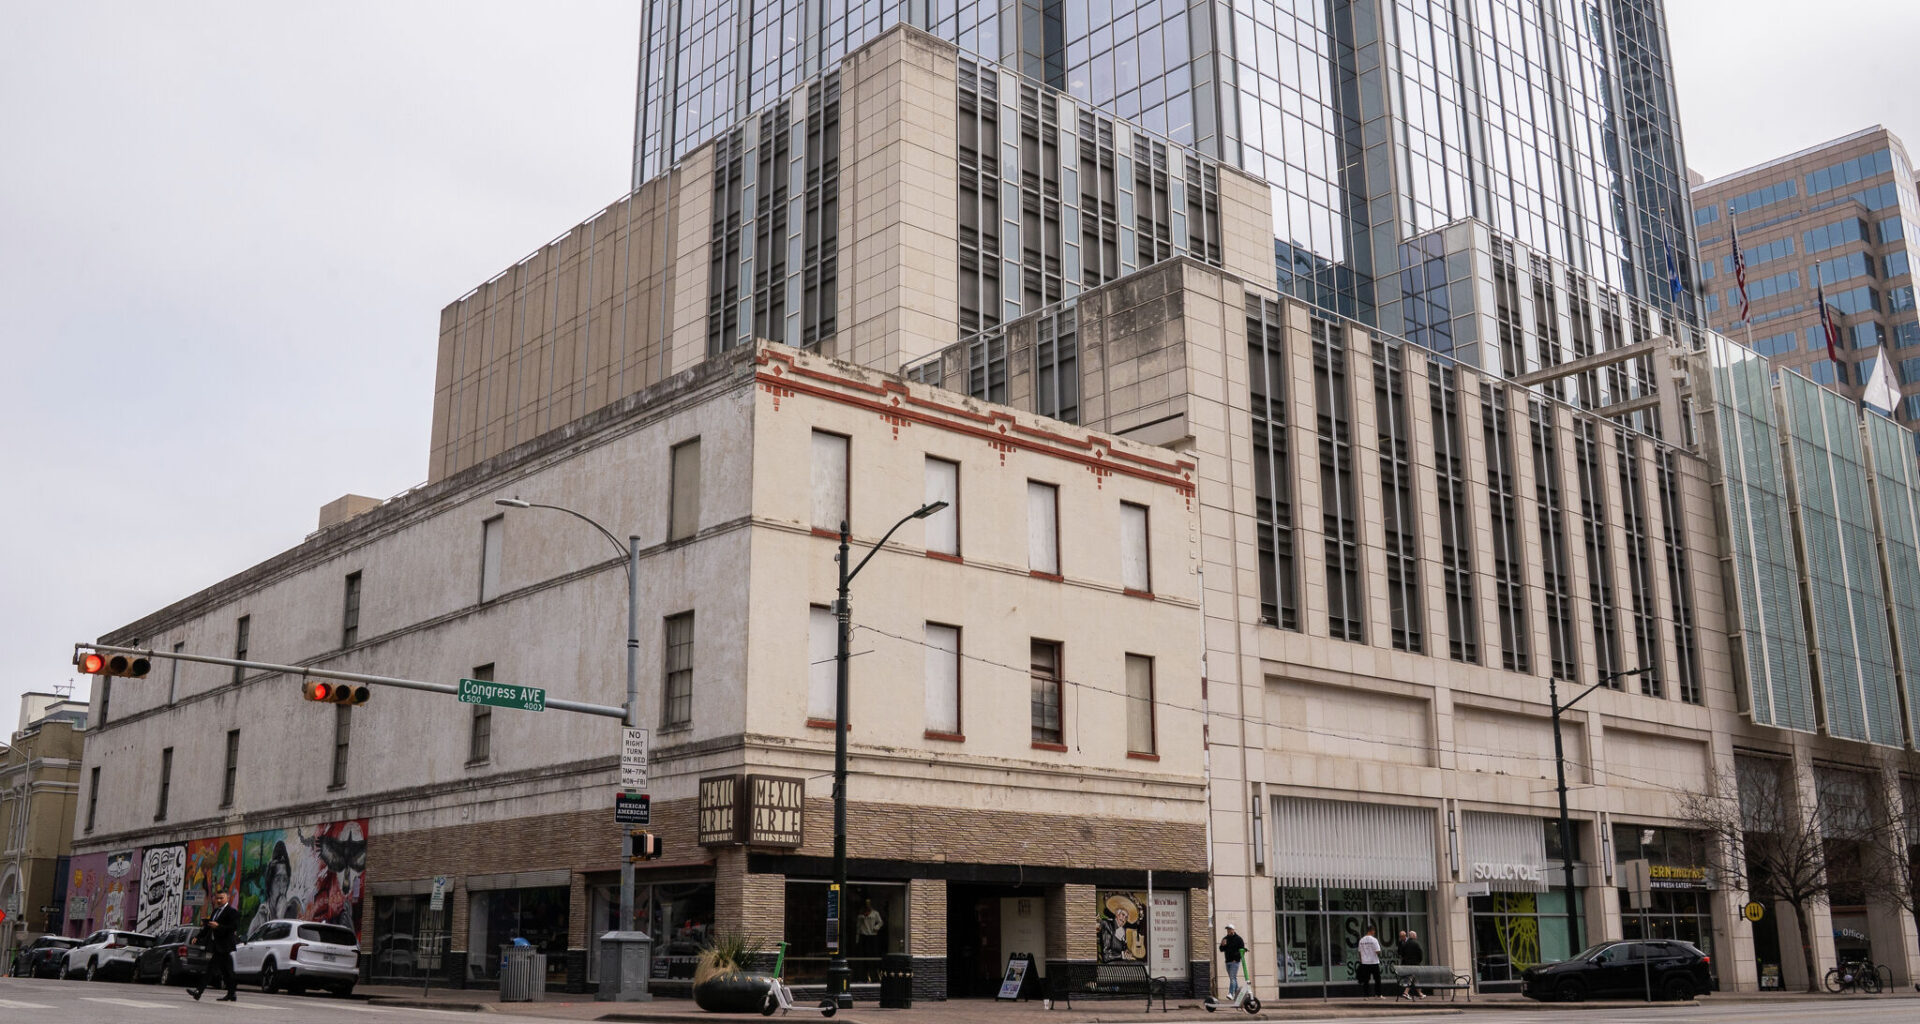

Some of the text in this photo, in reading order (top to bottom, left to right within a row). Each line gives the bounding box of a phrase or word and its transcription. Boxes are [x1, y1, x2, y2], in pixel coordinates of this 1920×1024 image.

[464, 680, 541, 703] Congress AVE
[466, 696, 481, 704] 500
[524, 702, 538, 711] 400
[628, 731, 641, 739] NO
[622, 767, 646, 775] 7AM-7PM
[622, 778, 646, 786] MON-FRI
[701, 780, 734, 808] MEXIC
[754, 779, 802, 809] MEXIC
[701, 808, 733, 833] ARTE
[754, 807, 801, 832] ARTE
[700, 833, 733, 842] MUSEUM
[753, 832, 800, 843] MUSEUM
[1474, 863, 1541, 881] SOULCYCLE
[1648, 865, 1671, 878] DERN
[1842, 928, 1865, 940] Office
